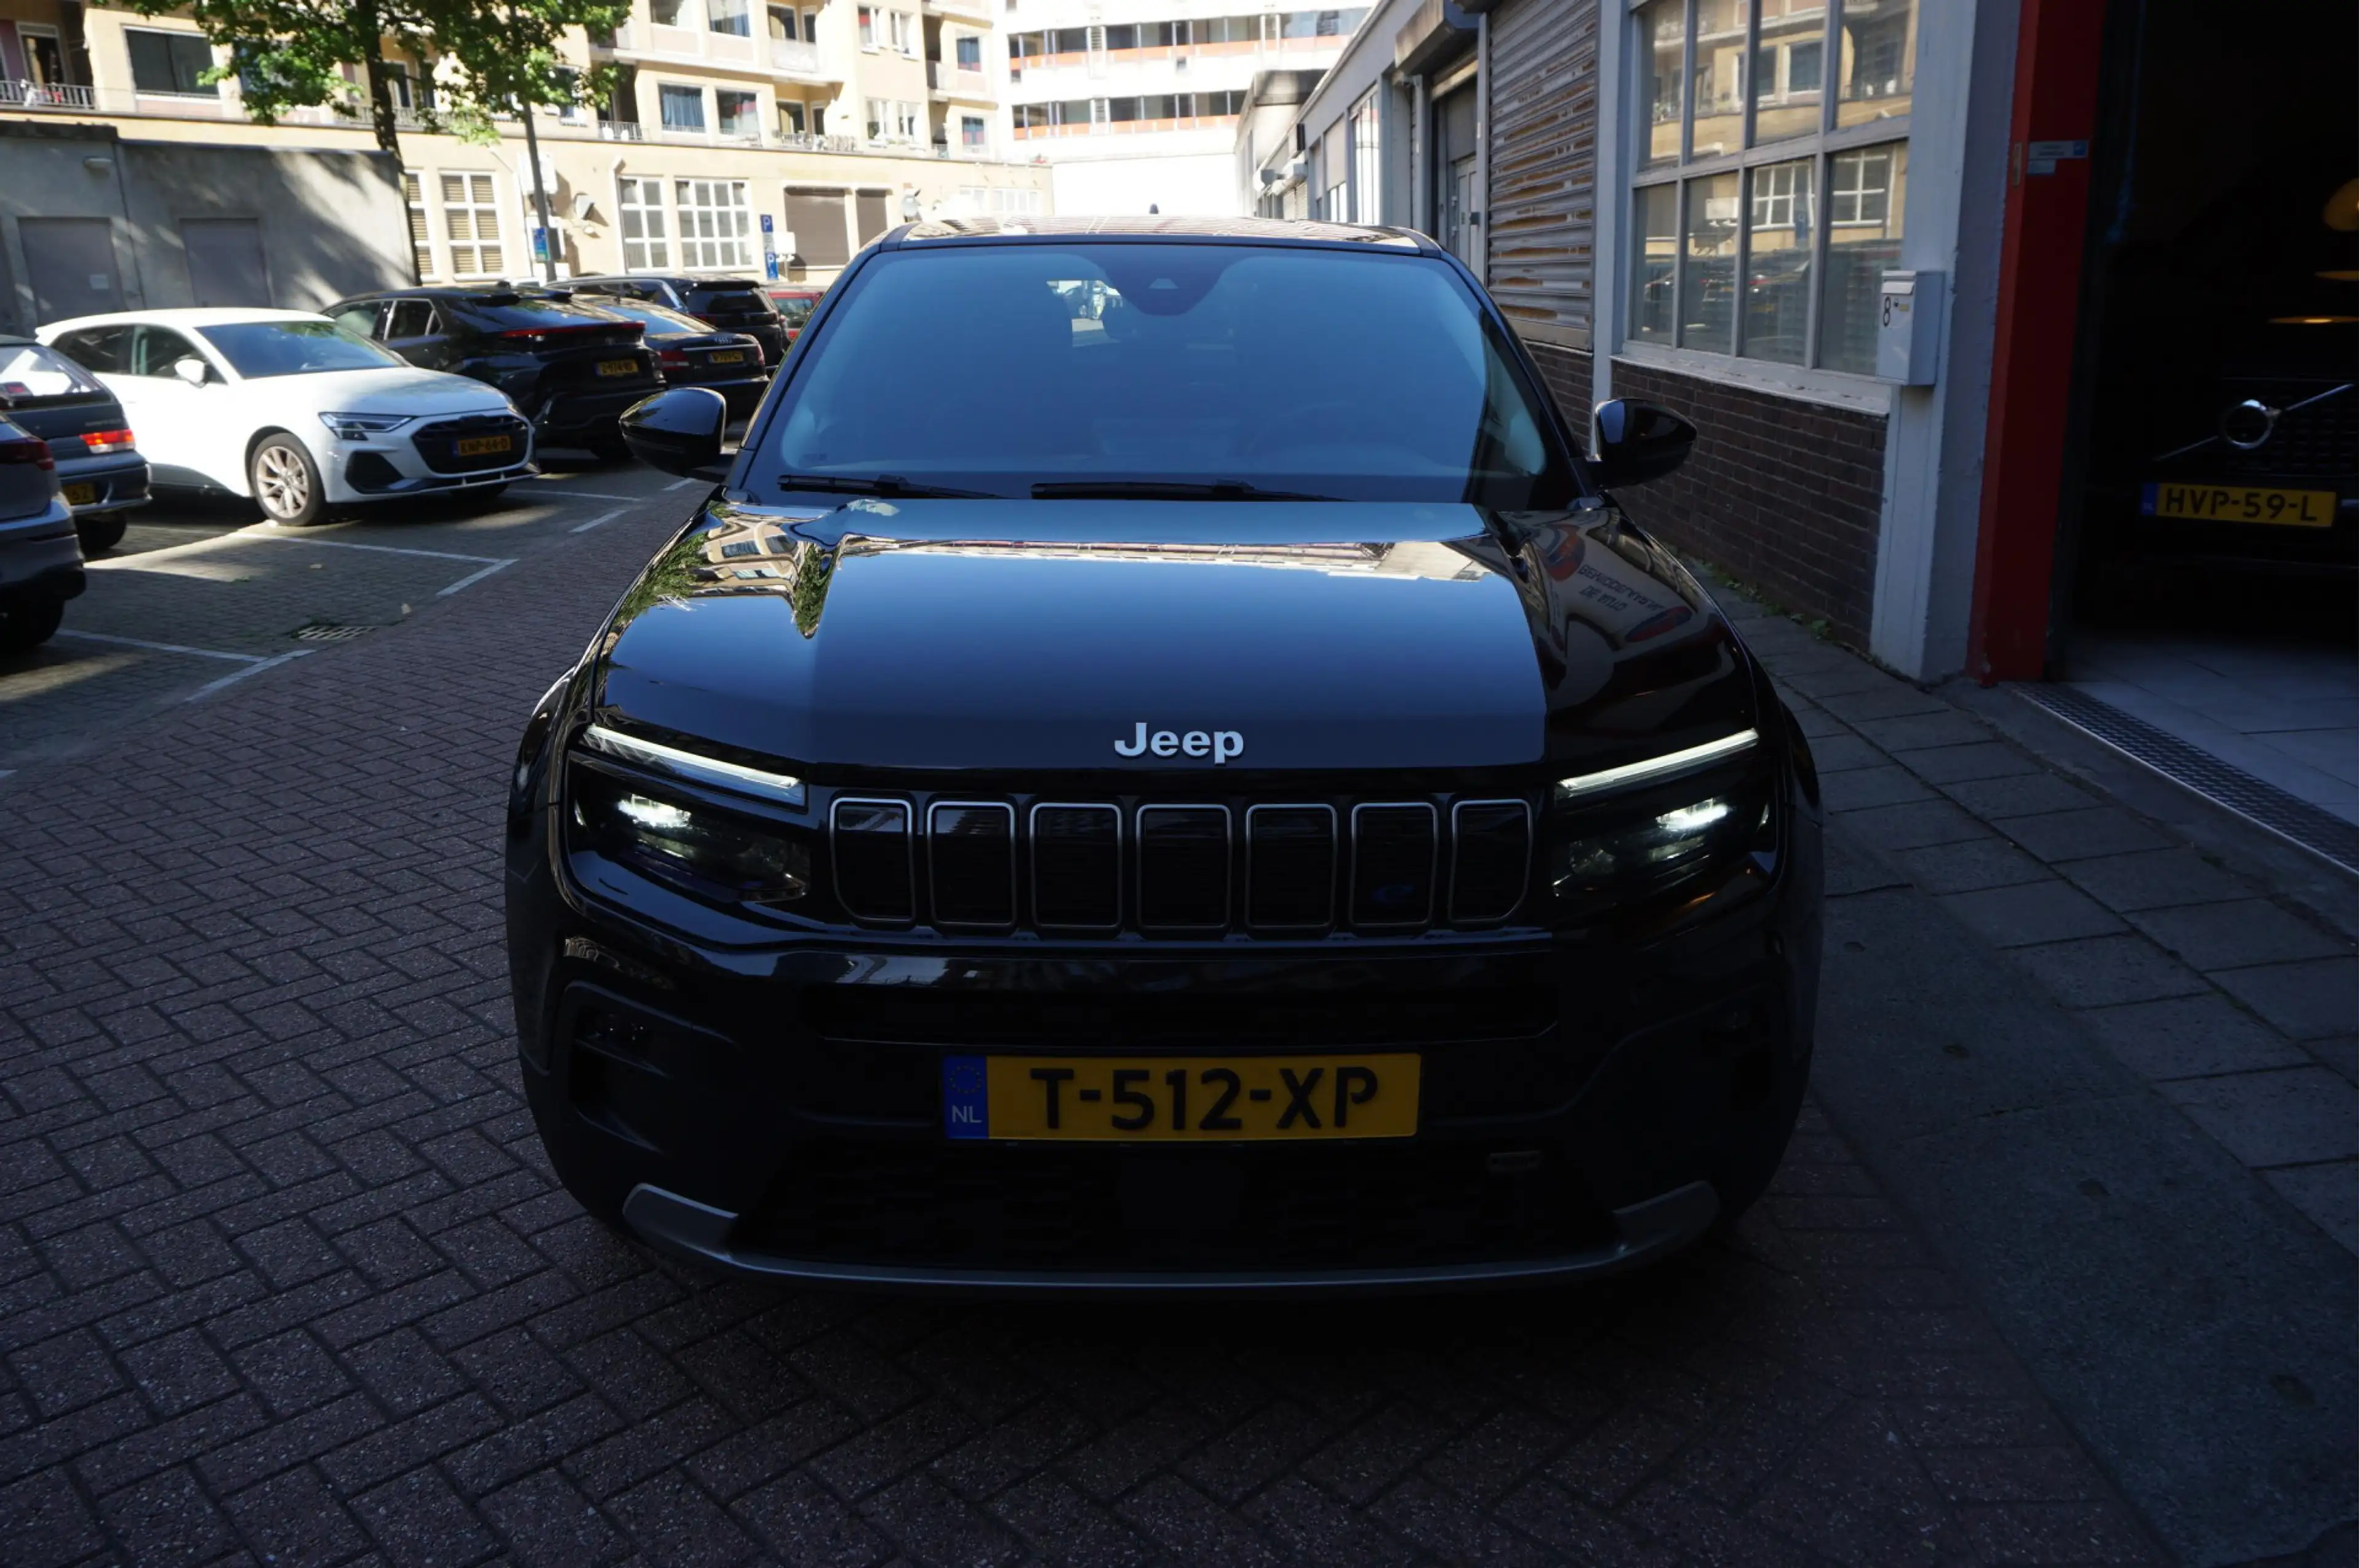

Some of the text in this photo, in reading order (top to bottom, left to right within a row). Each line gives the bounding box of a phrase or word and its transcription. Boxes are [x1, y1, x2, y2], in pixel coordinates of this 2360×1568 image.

[1883, 296, 1891, 327] 8
[2165, 488, 2317, 522] HVP-59-L
[1114, 721, 1245, 765] Jeep
[951, 1104, 983, 1124] NL
[1030, 1066, 1379, 1131] T-512-XP
